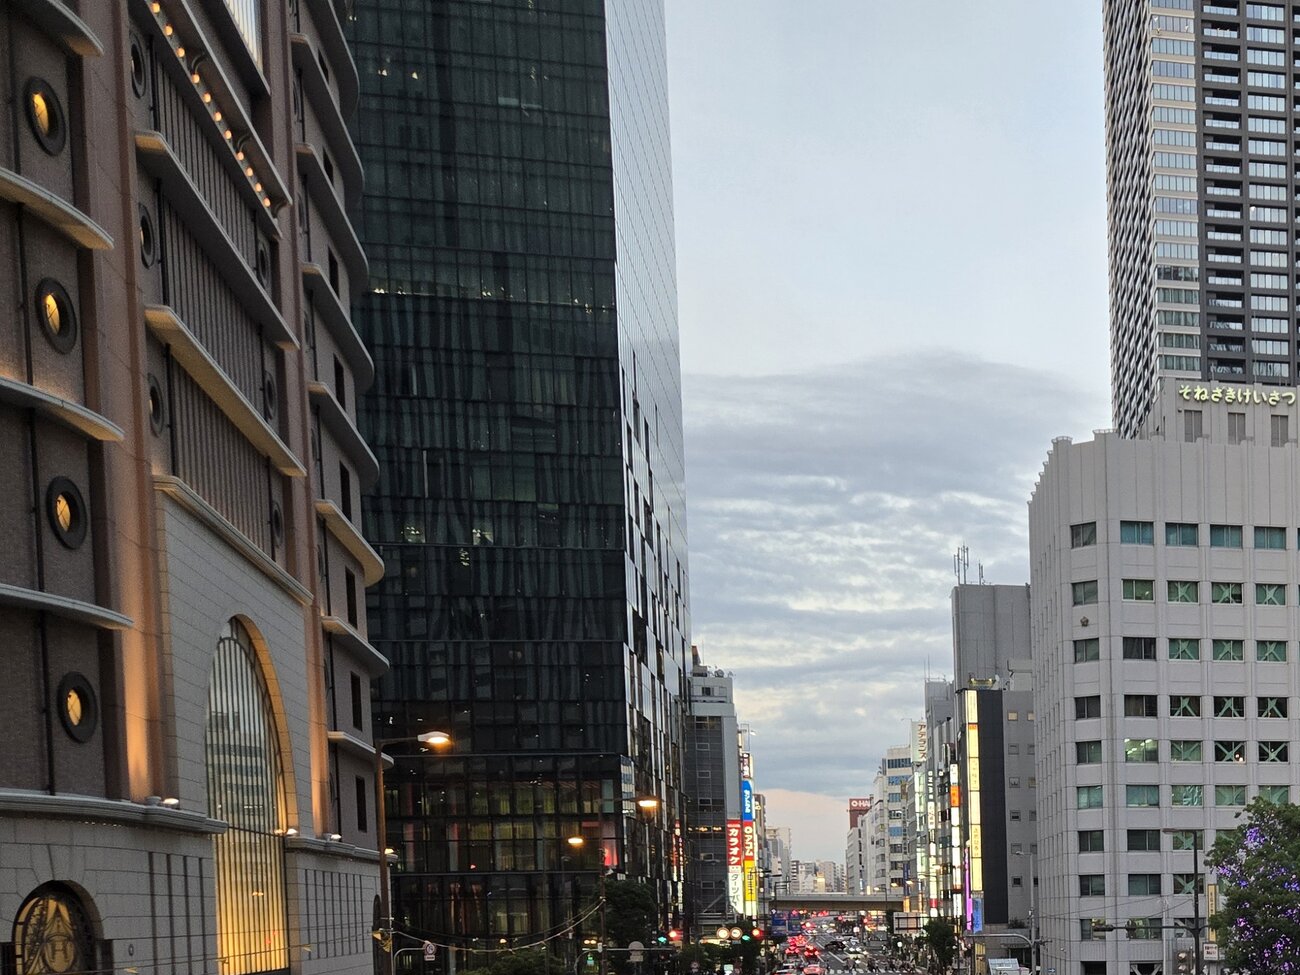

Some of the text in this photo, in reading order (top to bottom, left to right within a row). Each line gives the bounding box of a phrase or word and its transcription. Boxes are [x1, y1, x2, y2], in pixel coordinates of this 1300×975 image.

[1178, 384, 1296, 406] そねざきけいさつ
[728, 828, 740, 865] カラオケ
